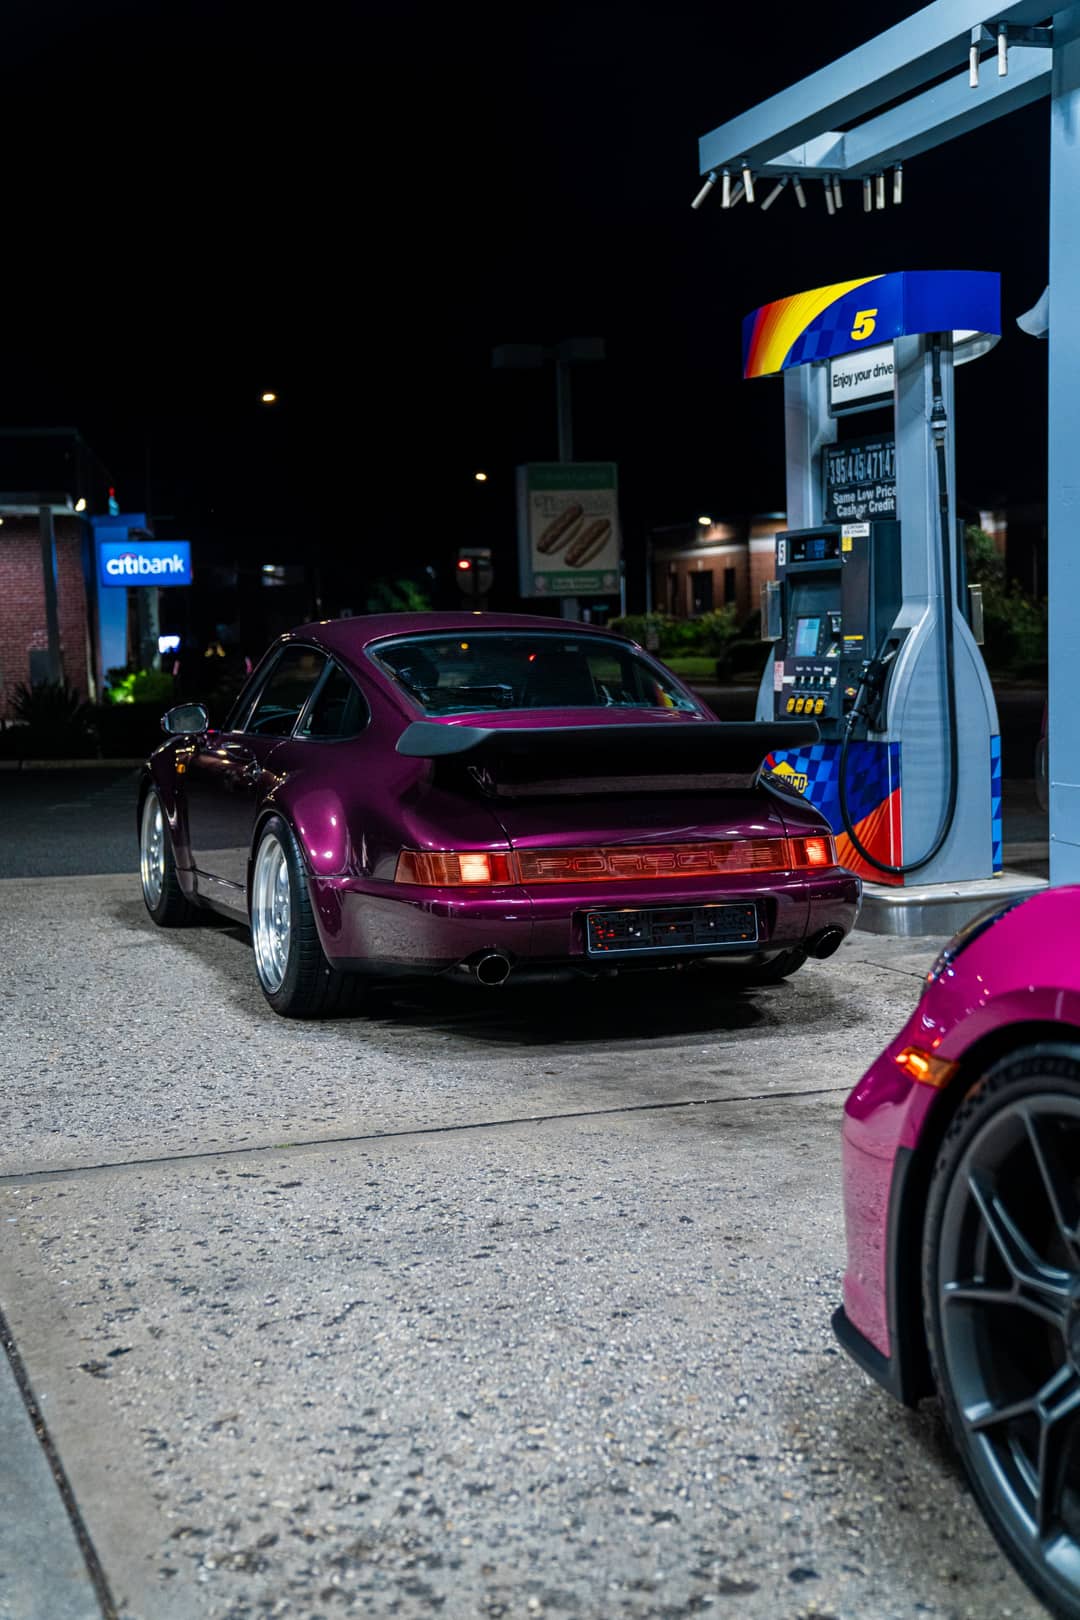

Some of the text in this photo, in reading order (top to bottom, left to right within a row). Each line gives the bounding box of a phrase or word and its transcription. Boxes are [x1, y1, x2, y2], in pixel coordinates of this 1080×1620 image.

[850, 308, 878, 341] 5
[832, 362, 894, 389] Enjoy your drive
[833, 491, 856, 505] Same
[857, 488, 874, 501] Low
[836, 504, 857, 518] Cash
[868, 498, 895, 513] Credit
[106, 554, 185, 575] citibank
[536, 847, 773, 875] PORSCHE
